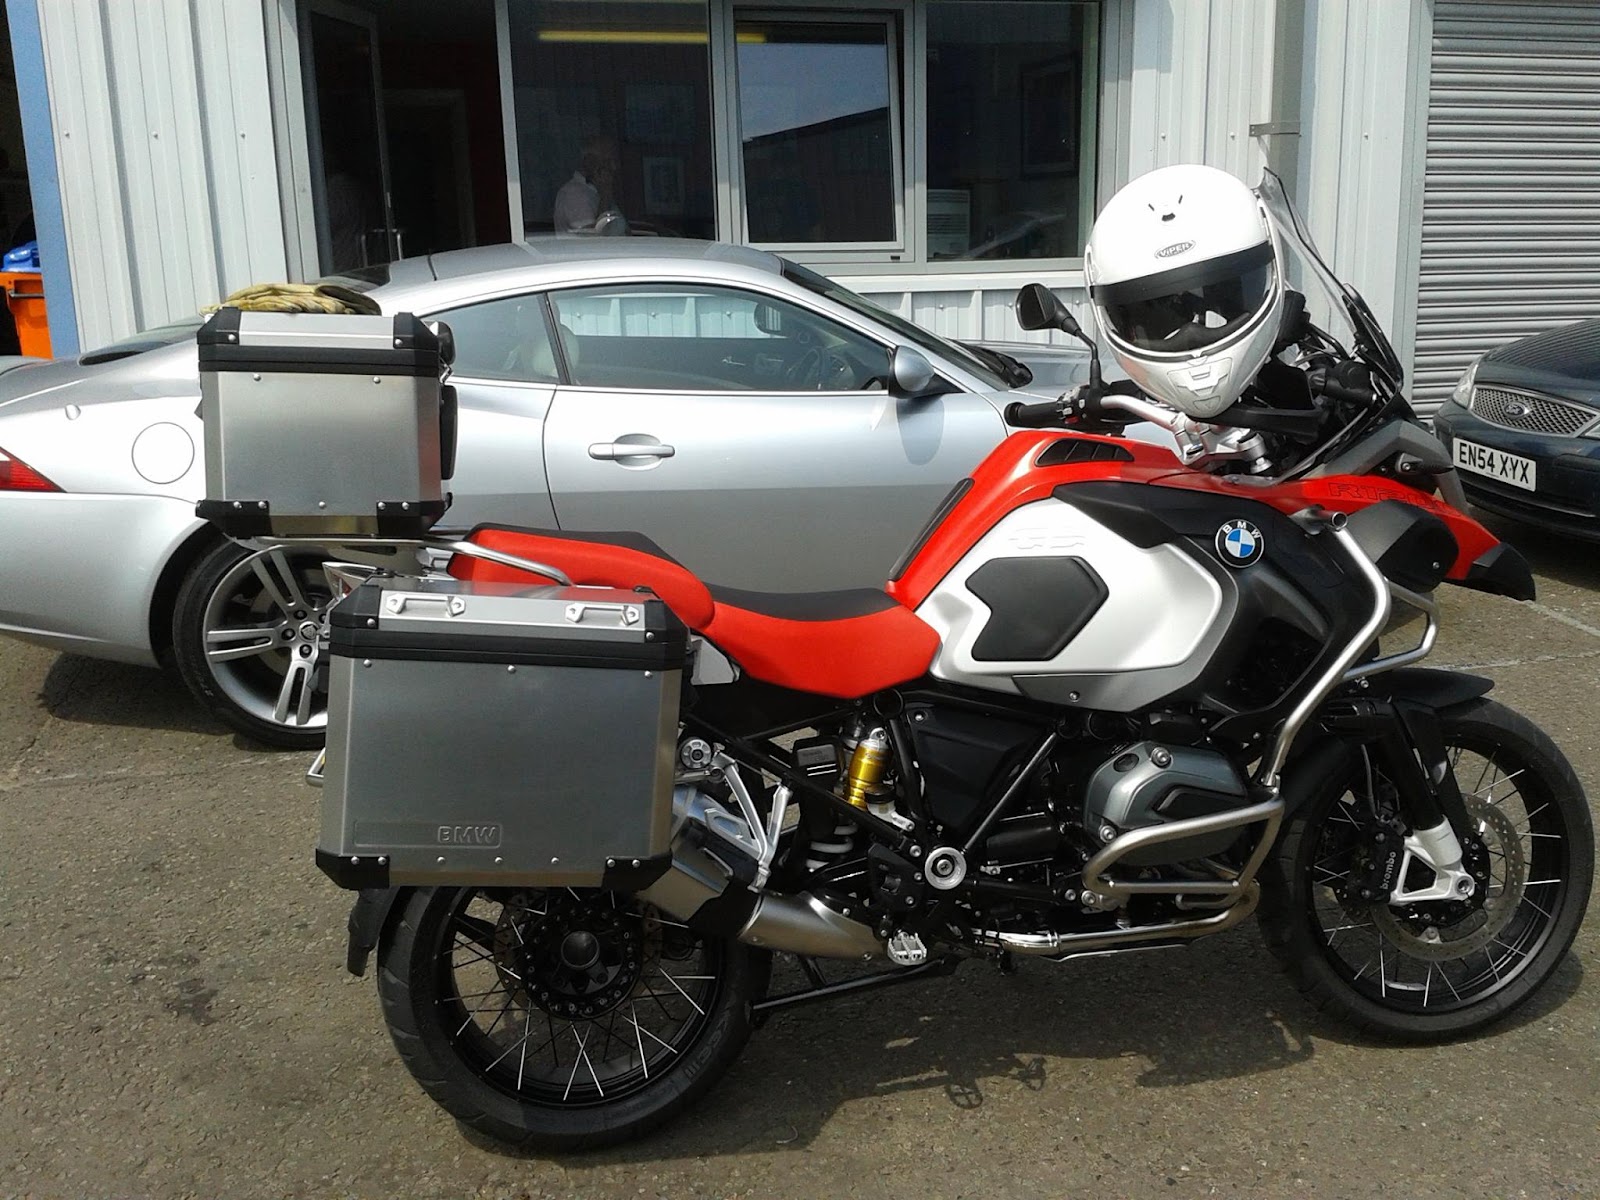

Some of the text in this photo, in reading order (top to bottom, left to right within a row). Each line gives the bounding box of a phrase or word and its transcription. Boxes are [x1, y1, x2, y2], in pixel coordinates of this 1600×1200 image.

[1459, 442, 1530, 484] EN54 XYX
[1221, 520, 1262, 539] BMW
[437, 825, 497, 844] BMW
